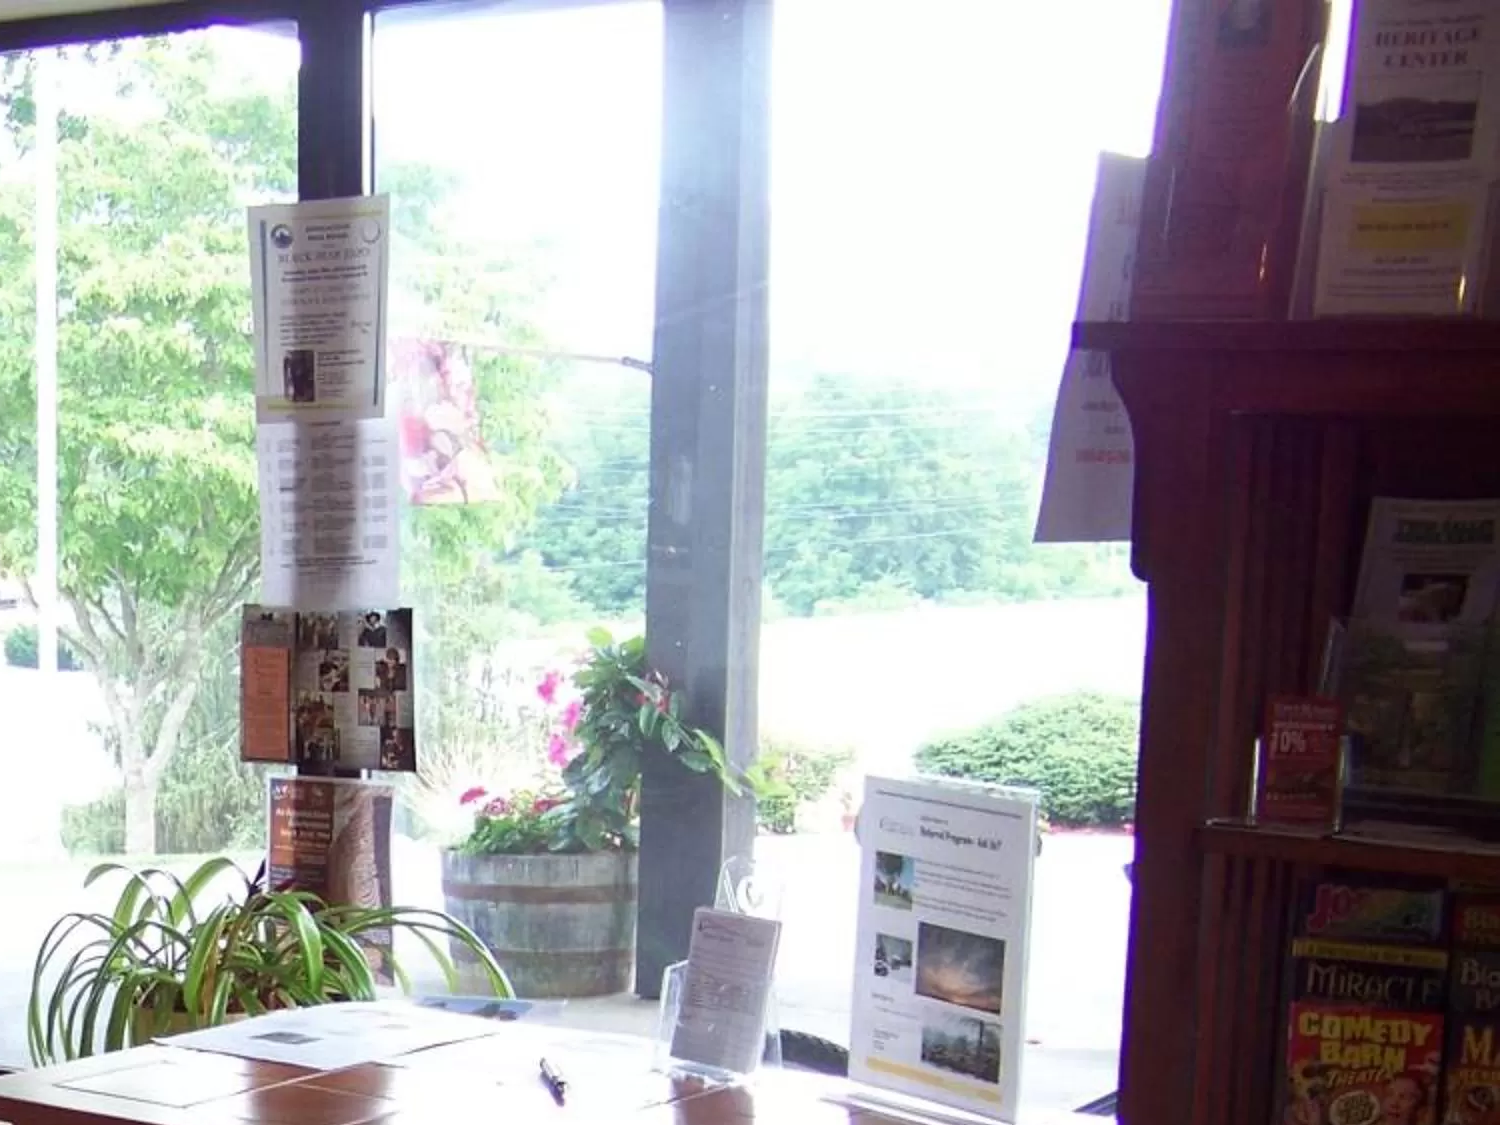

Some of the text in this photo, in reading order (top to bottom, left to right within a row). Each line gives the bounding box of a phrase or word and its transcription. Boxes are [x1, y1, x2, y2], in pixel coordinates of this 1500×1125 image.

[1382, 50, 1468, 69] CENTER
[1298, 1011, 1433, 1047] COMEDY
[1319, 1040, 1406, 1074] BARN
